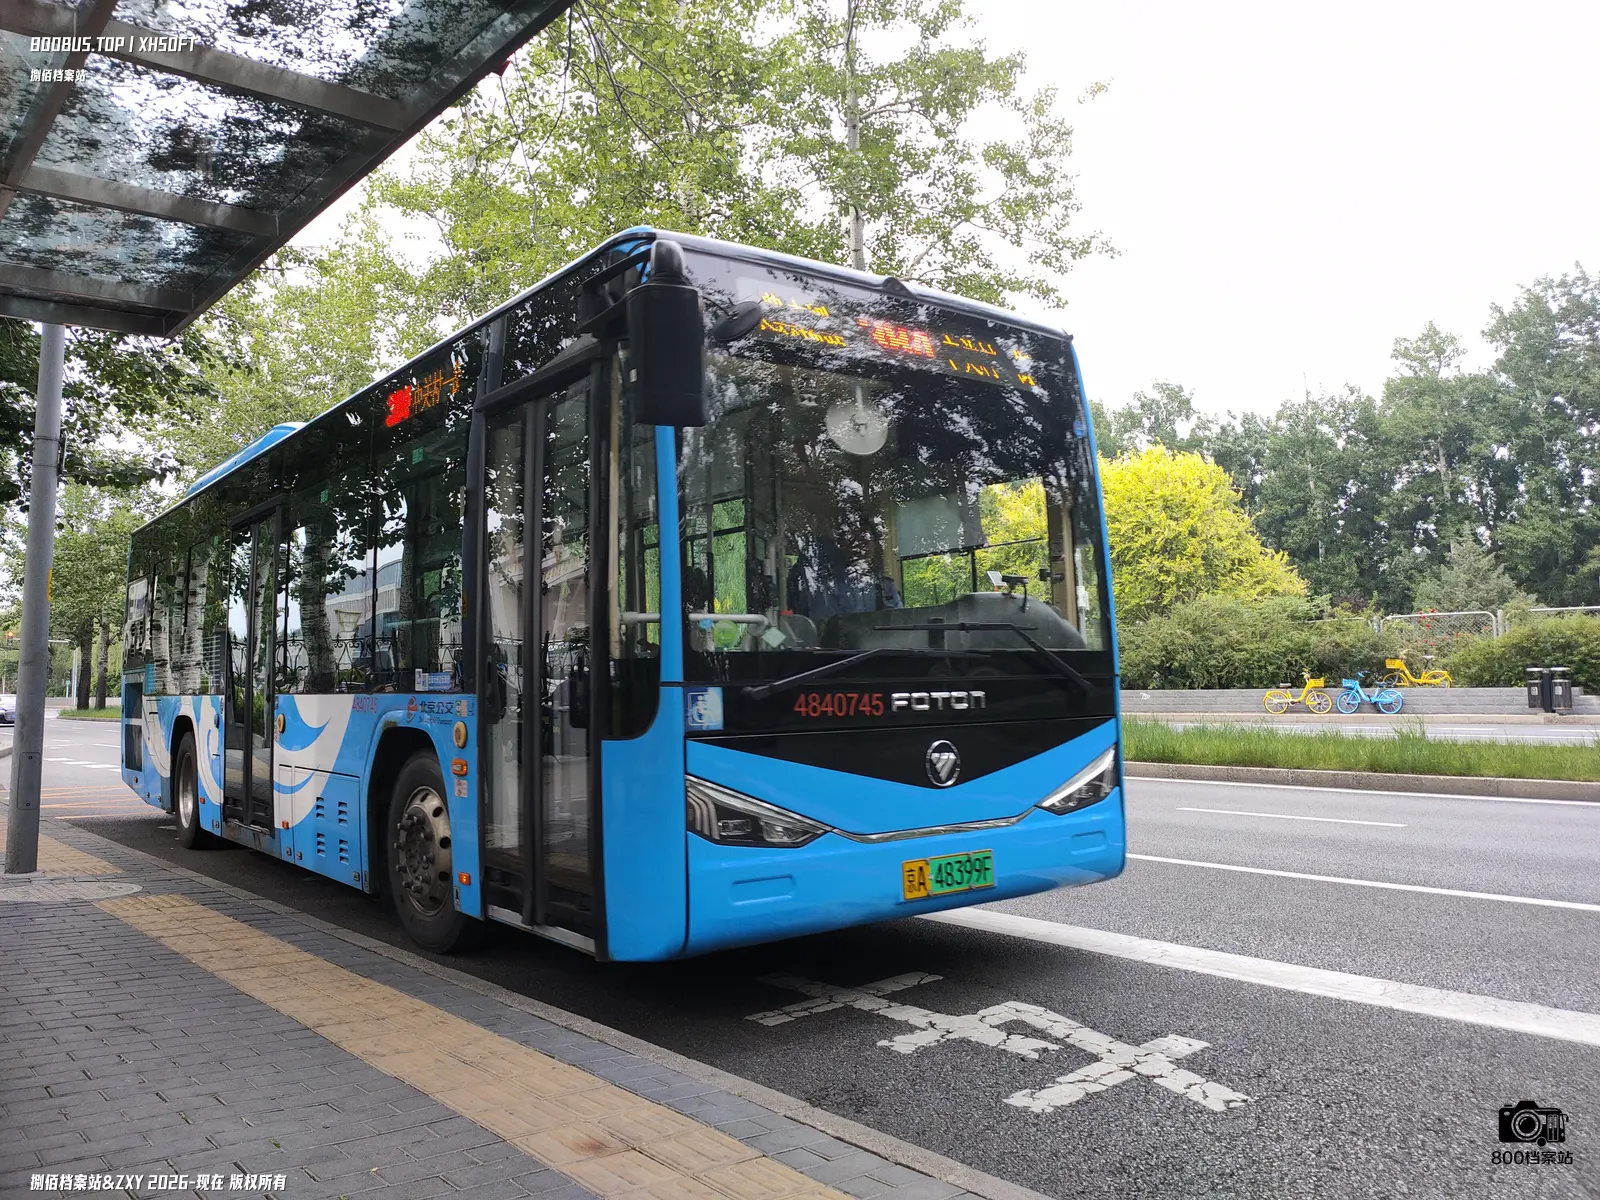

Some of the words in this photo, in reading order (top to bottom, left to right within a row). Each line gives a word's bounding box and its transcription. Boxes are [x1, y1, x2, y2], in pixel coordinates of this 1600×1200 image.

[419, 700, 455, 715] 北京公交
[793, 692, 885, 717] 4840745
[890, 690, 987, 712] FOTON
